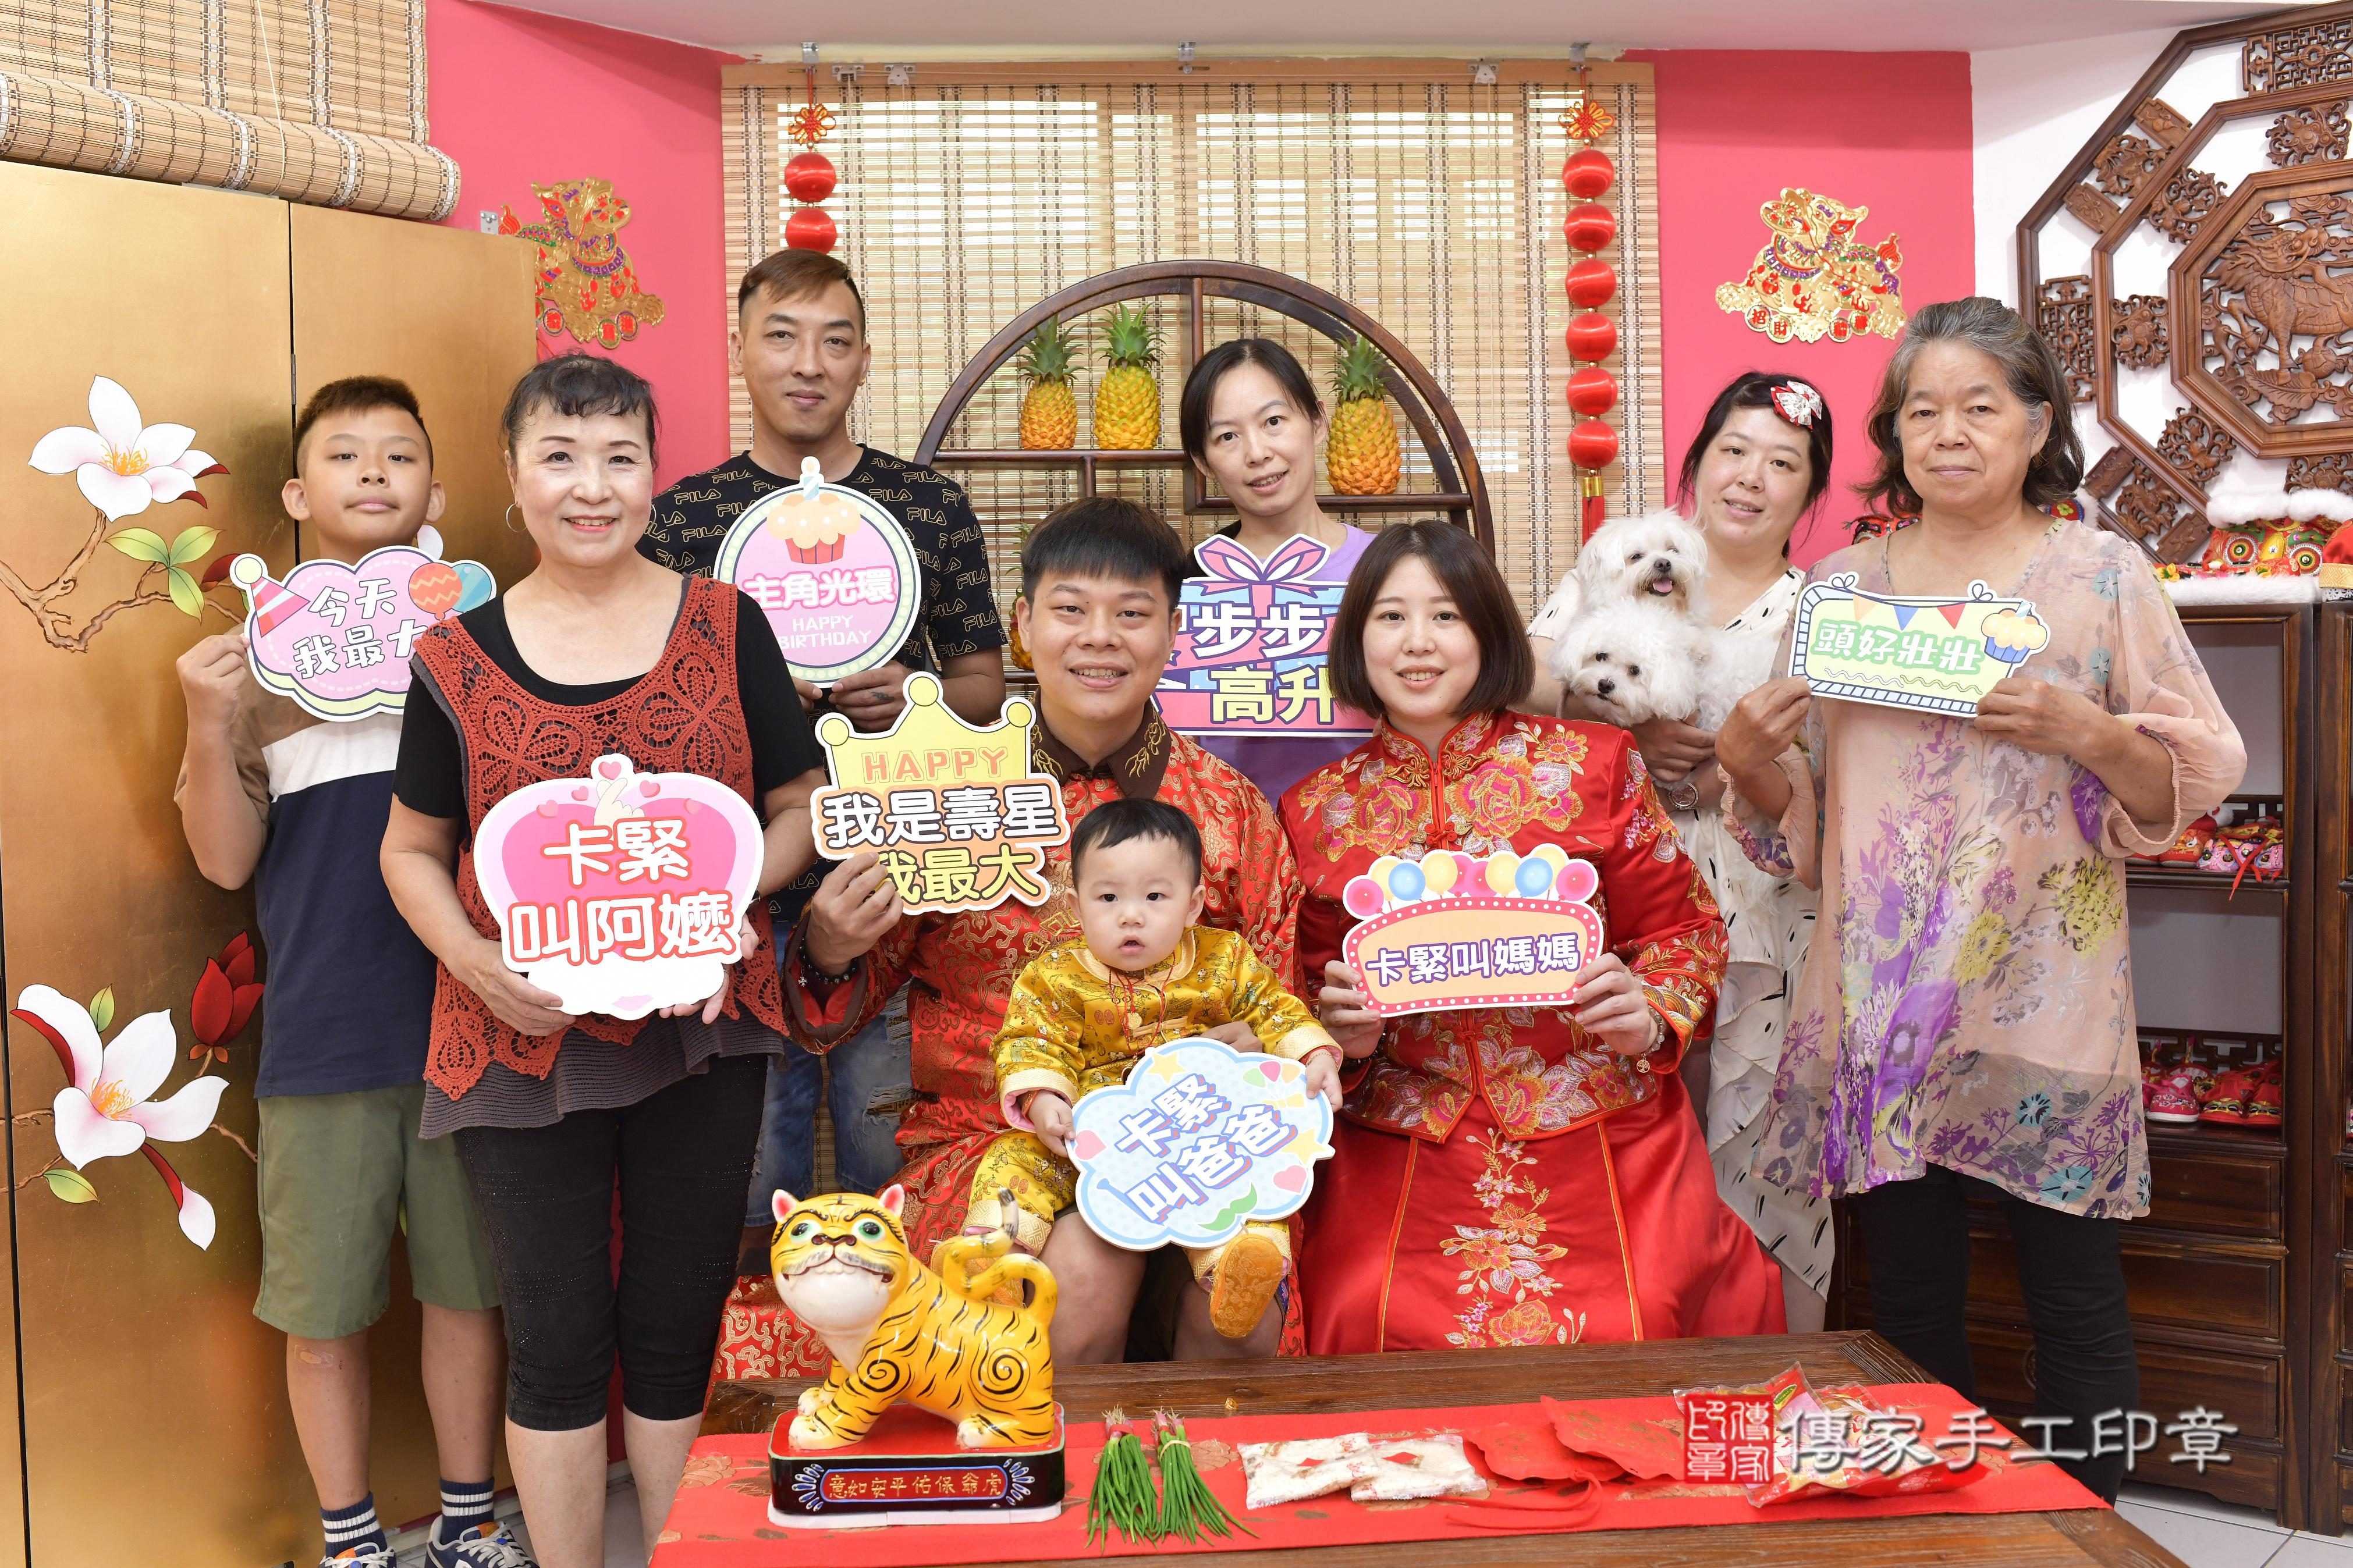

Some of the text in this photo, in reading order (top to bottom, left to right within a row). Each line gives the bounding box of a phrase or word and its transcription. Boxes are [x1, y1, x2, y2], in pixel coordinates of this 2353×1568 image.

[903, 471, 946, 484] FILA
[675, 489, 721, 504] FILA
[869, 489, 912, 501] FILA
[907, 507, 946, 525] FILA
[682, 525, 727, 542] FILA
[950, 524, 981, 548] FILA
[656, 549, 694, 571] FILA
[743, 567, 896, 609] 主角光環
[956, 568, 988, 590] FILA
[308, 578, 397, 627] 今天
[930, 598, 967, 621] FILA
[792, 614, 854, 632] HAPPY
[963, 610, 997, 631] FILA
[778, 630, 871, 649] BIRTHDAY
[936, 640, 977, 658] FILA
[1812, 621, 1982, 673] 頭好壯壯
[1209, 664, 1335, 724] 高升
[863, 748, 1007, 783] HAPPY
[821, 783, 1060, 848] 我是壽星
[541, 817, 690, 888] 卡緊
[509, 888, 736, 965] 叫阿嬤
[1365, 933, 1580, 987] 卡緊叫媽媽
[1115, 1073, 1230, 1157] 卡緊
[1126, 1104, 1297, 1223] 叫爸爸
